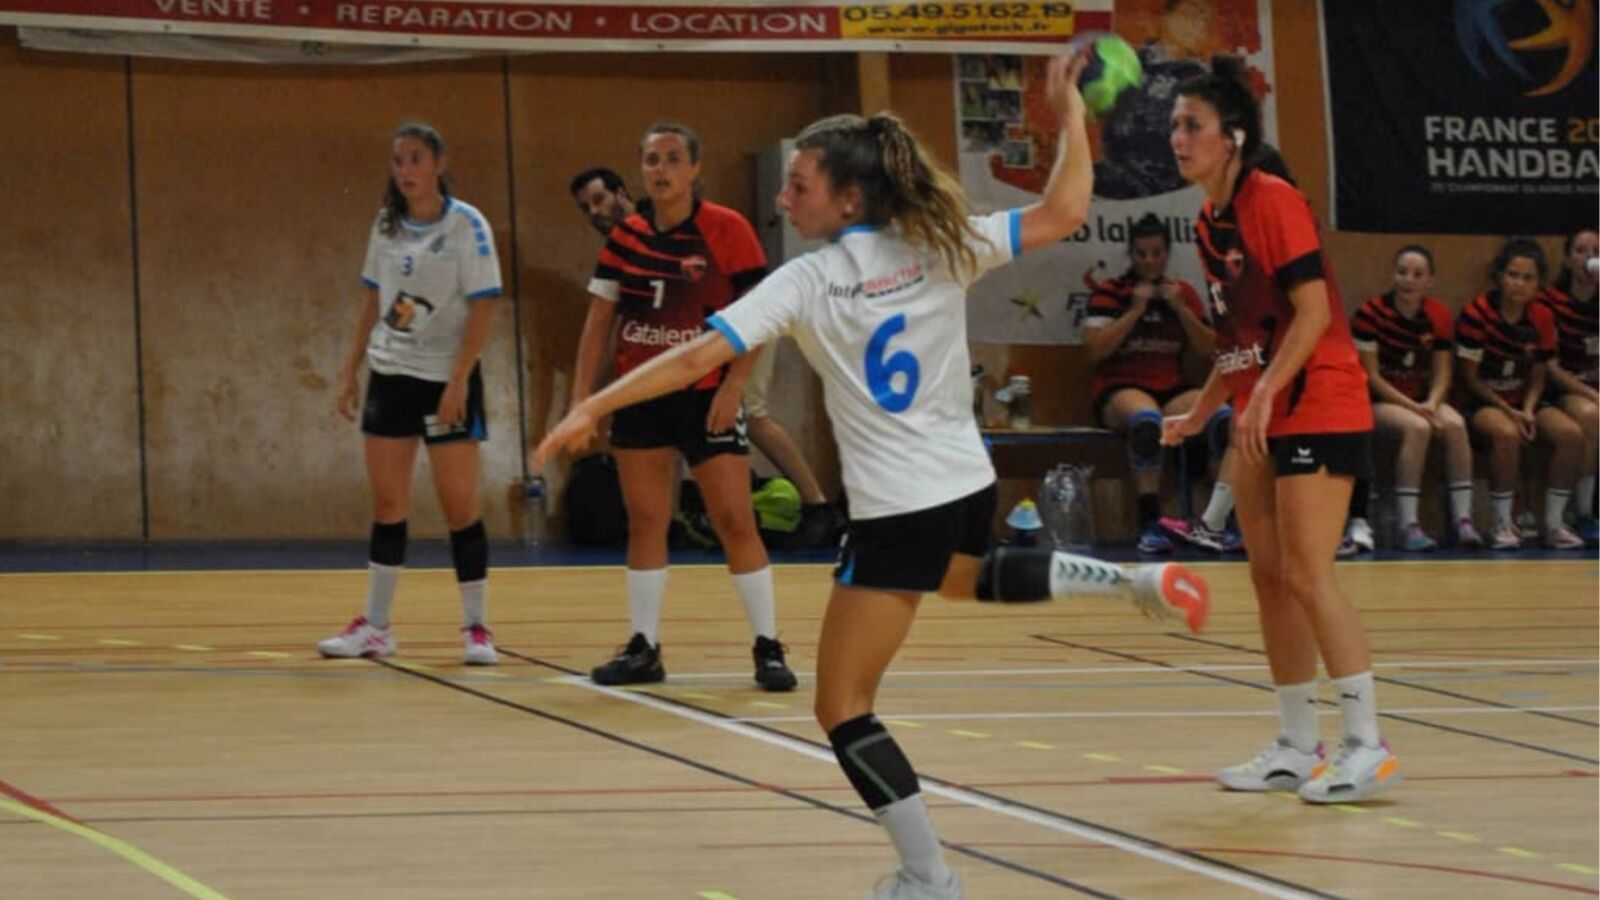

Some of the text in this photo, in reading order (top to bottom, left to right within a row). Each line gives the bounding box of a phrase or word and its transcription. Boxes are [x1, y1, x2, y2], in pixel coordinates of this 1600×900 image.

[155, 0, 826, 34] VENTE REPARATION LOCATION
[1424, 115, 1558, 143] FRANCE
[1426, 147, 1599, 179] HANDBA
[402, 255, 413, 277] 3
[863, 312, 921, 414] 6
